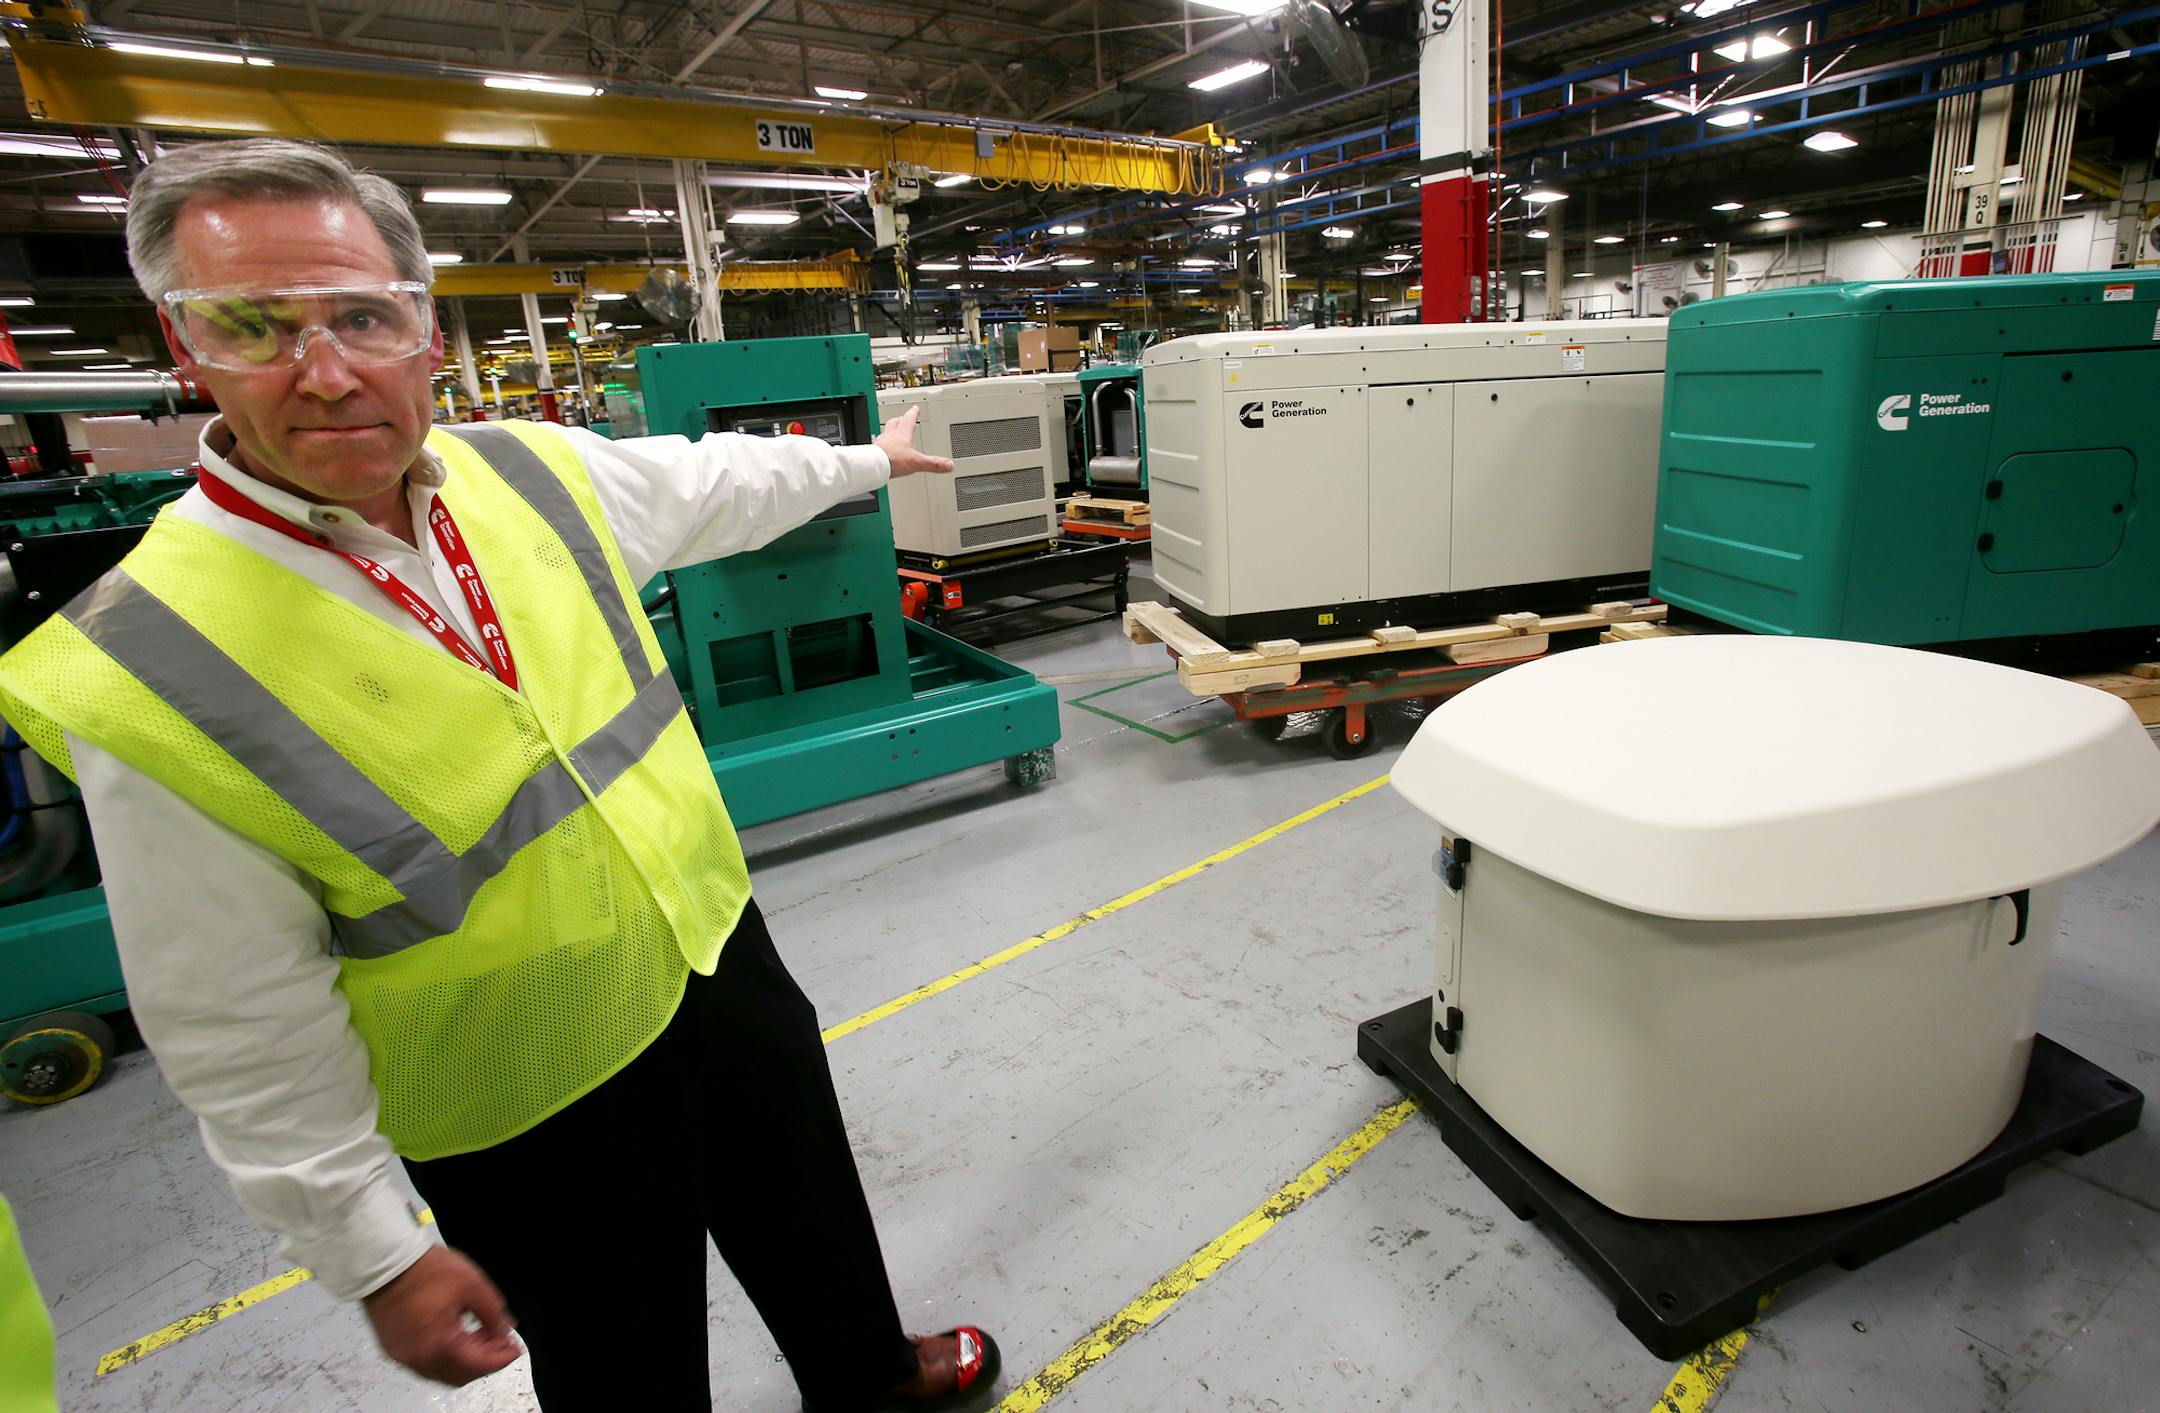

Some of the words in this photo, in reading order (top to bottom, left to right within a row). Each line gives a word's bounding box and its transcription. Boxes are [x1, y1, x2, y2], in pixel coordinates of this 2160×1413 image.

[1432, 0, 1452, 30] S
[758, 123, 771, 146] 3
[776, 124, 813, 149] TON
[1975, 194, 1988, 209] 39
[1976, 210, 1984, 225] Q
[552, 270, 561, 283] 3
[1272, 401, 1303, 409] Power
[1920, 393, 1961, 404] Power
[1272, 407, 1327, 418] Generation
[1919, 403, 1990, 417] Generation
